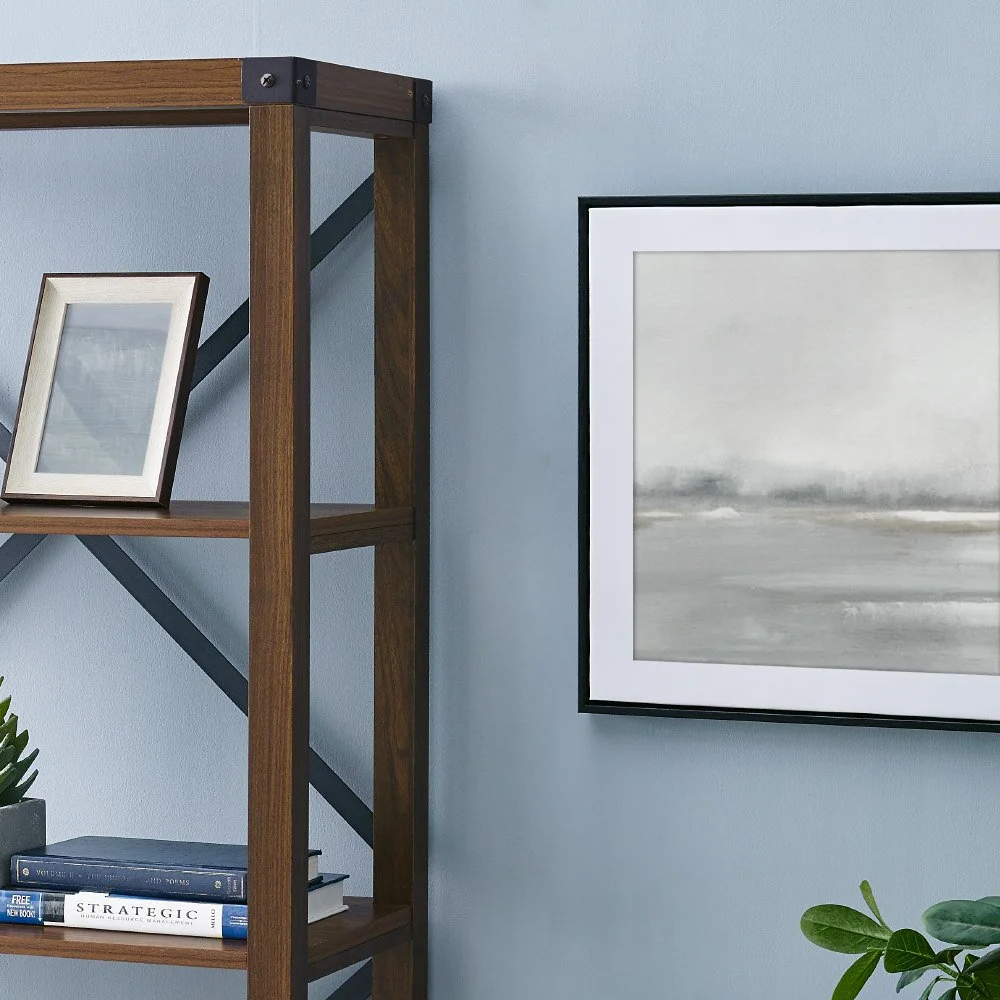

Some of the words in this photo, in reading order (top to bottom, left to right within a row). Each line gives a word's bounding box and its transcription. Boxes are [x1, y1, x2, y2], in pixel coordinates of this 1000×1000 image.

[11, 894, 31, 905] FREE
[6, 909, 19, 917] NEW
[76, 902, 199, 920] STRATEGIC
